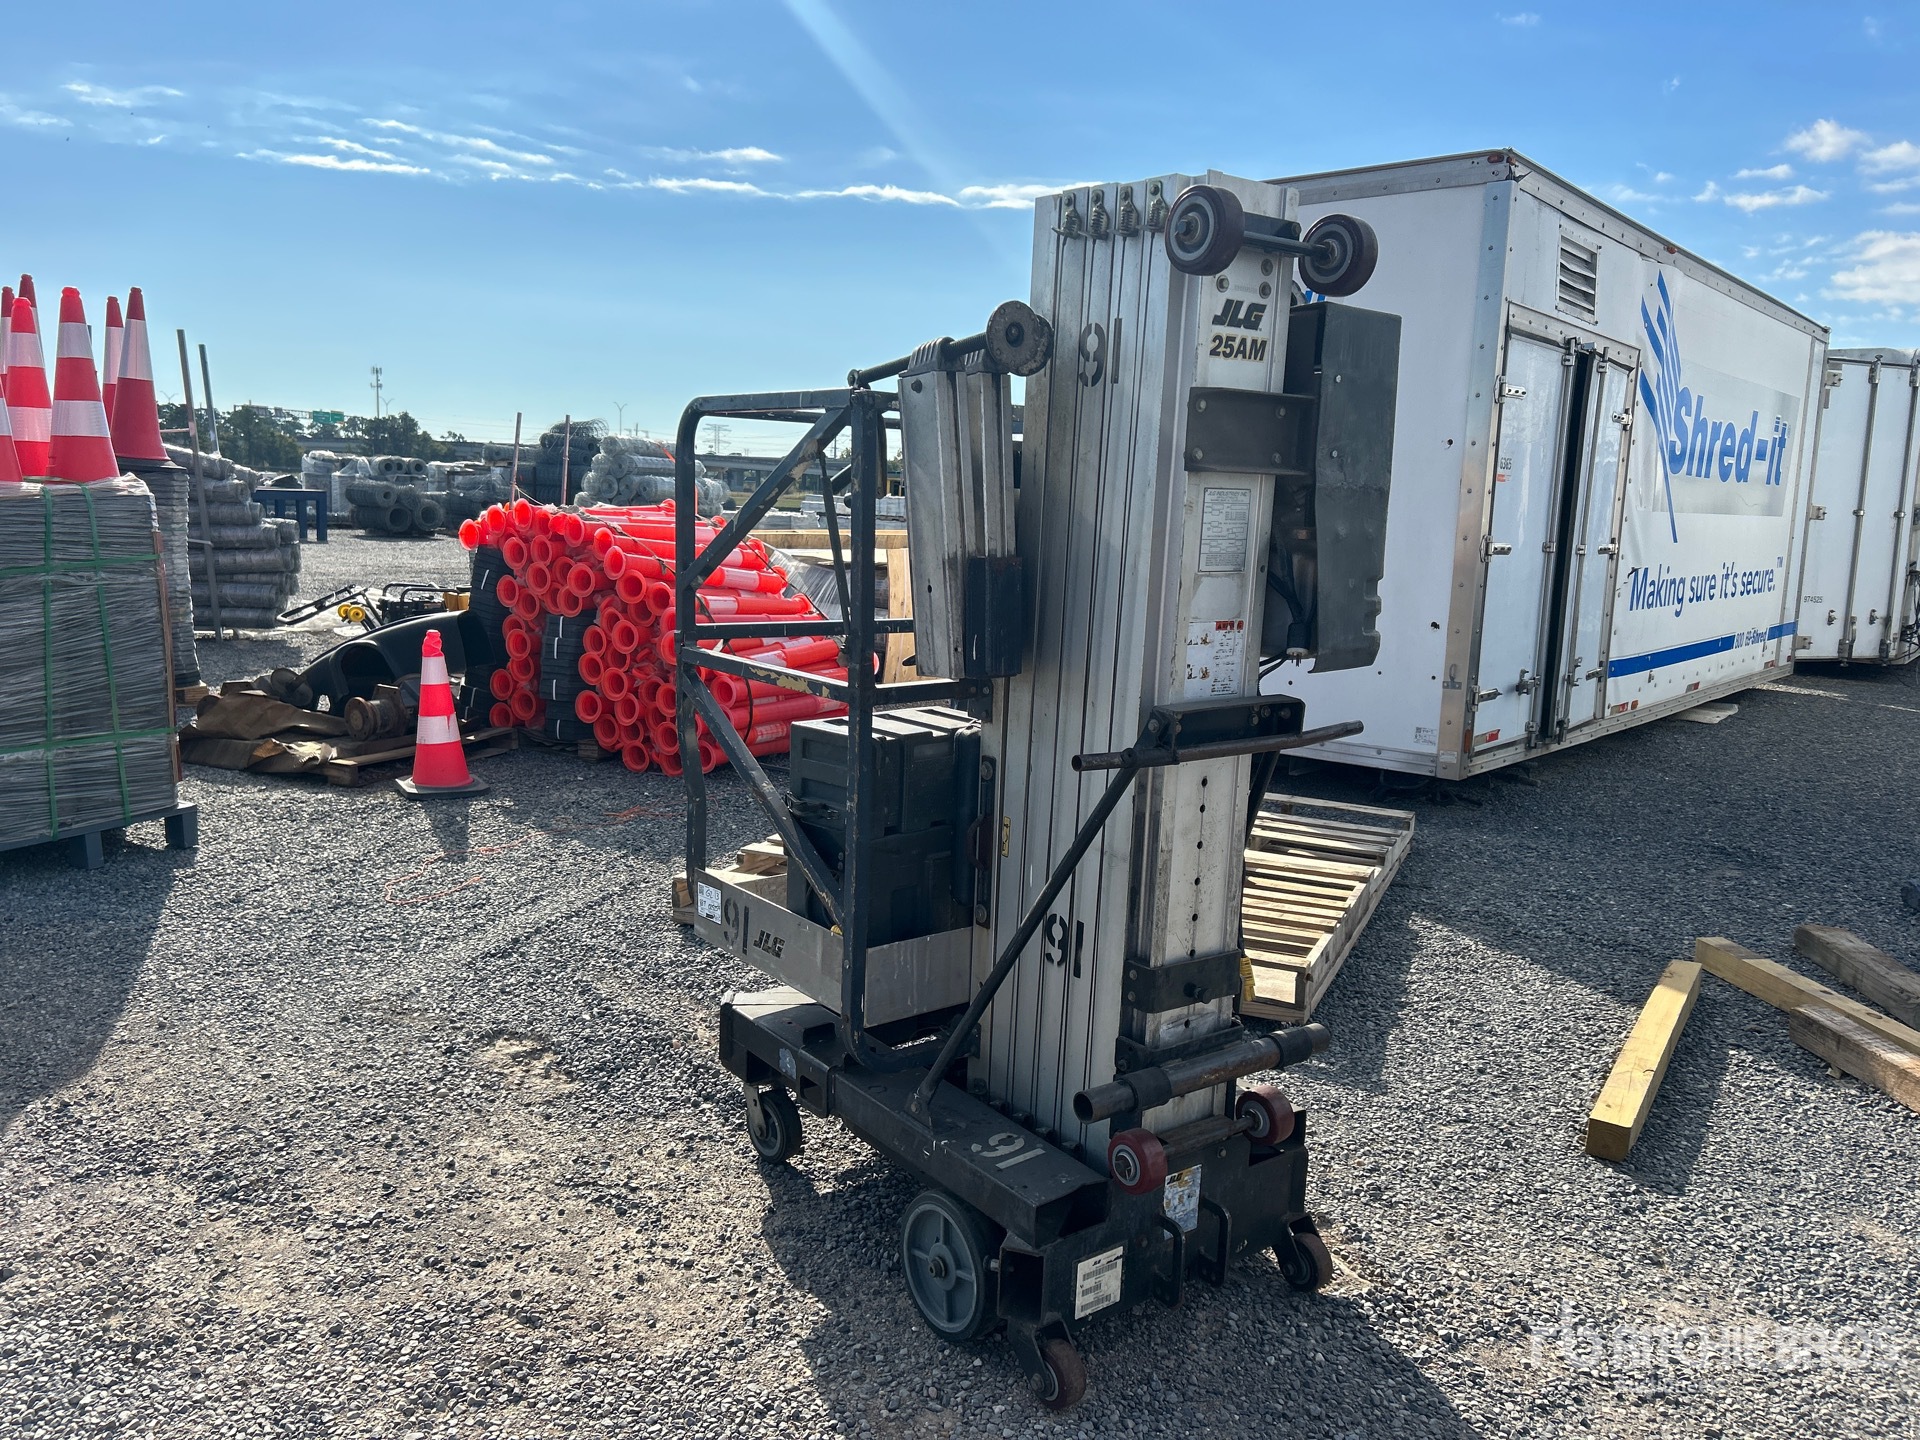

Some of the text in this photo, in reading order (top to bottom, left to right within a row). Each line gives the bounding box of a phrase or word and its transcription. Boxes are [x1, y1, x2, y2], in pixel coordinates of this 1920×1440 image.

[1212, 298, 1267, 331] JLG
[1079, 317, 1123, 387] 91
[1209, 334, 1268, 361] 25AM
[1669, 386, 1788, 486] Shred-it
[1629, 563, 1686, 617] Making
[1688, 573, 1717, 604] sure
[1719, 562, 1738, 600] it's
[1739, 566, 1776, 598] secure.
[723, 897, 749, 956] 91
[752, 929, 786, 959] JLG
[1045, 913, 1085, 979] 91
